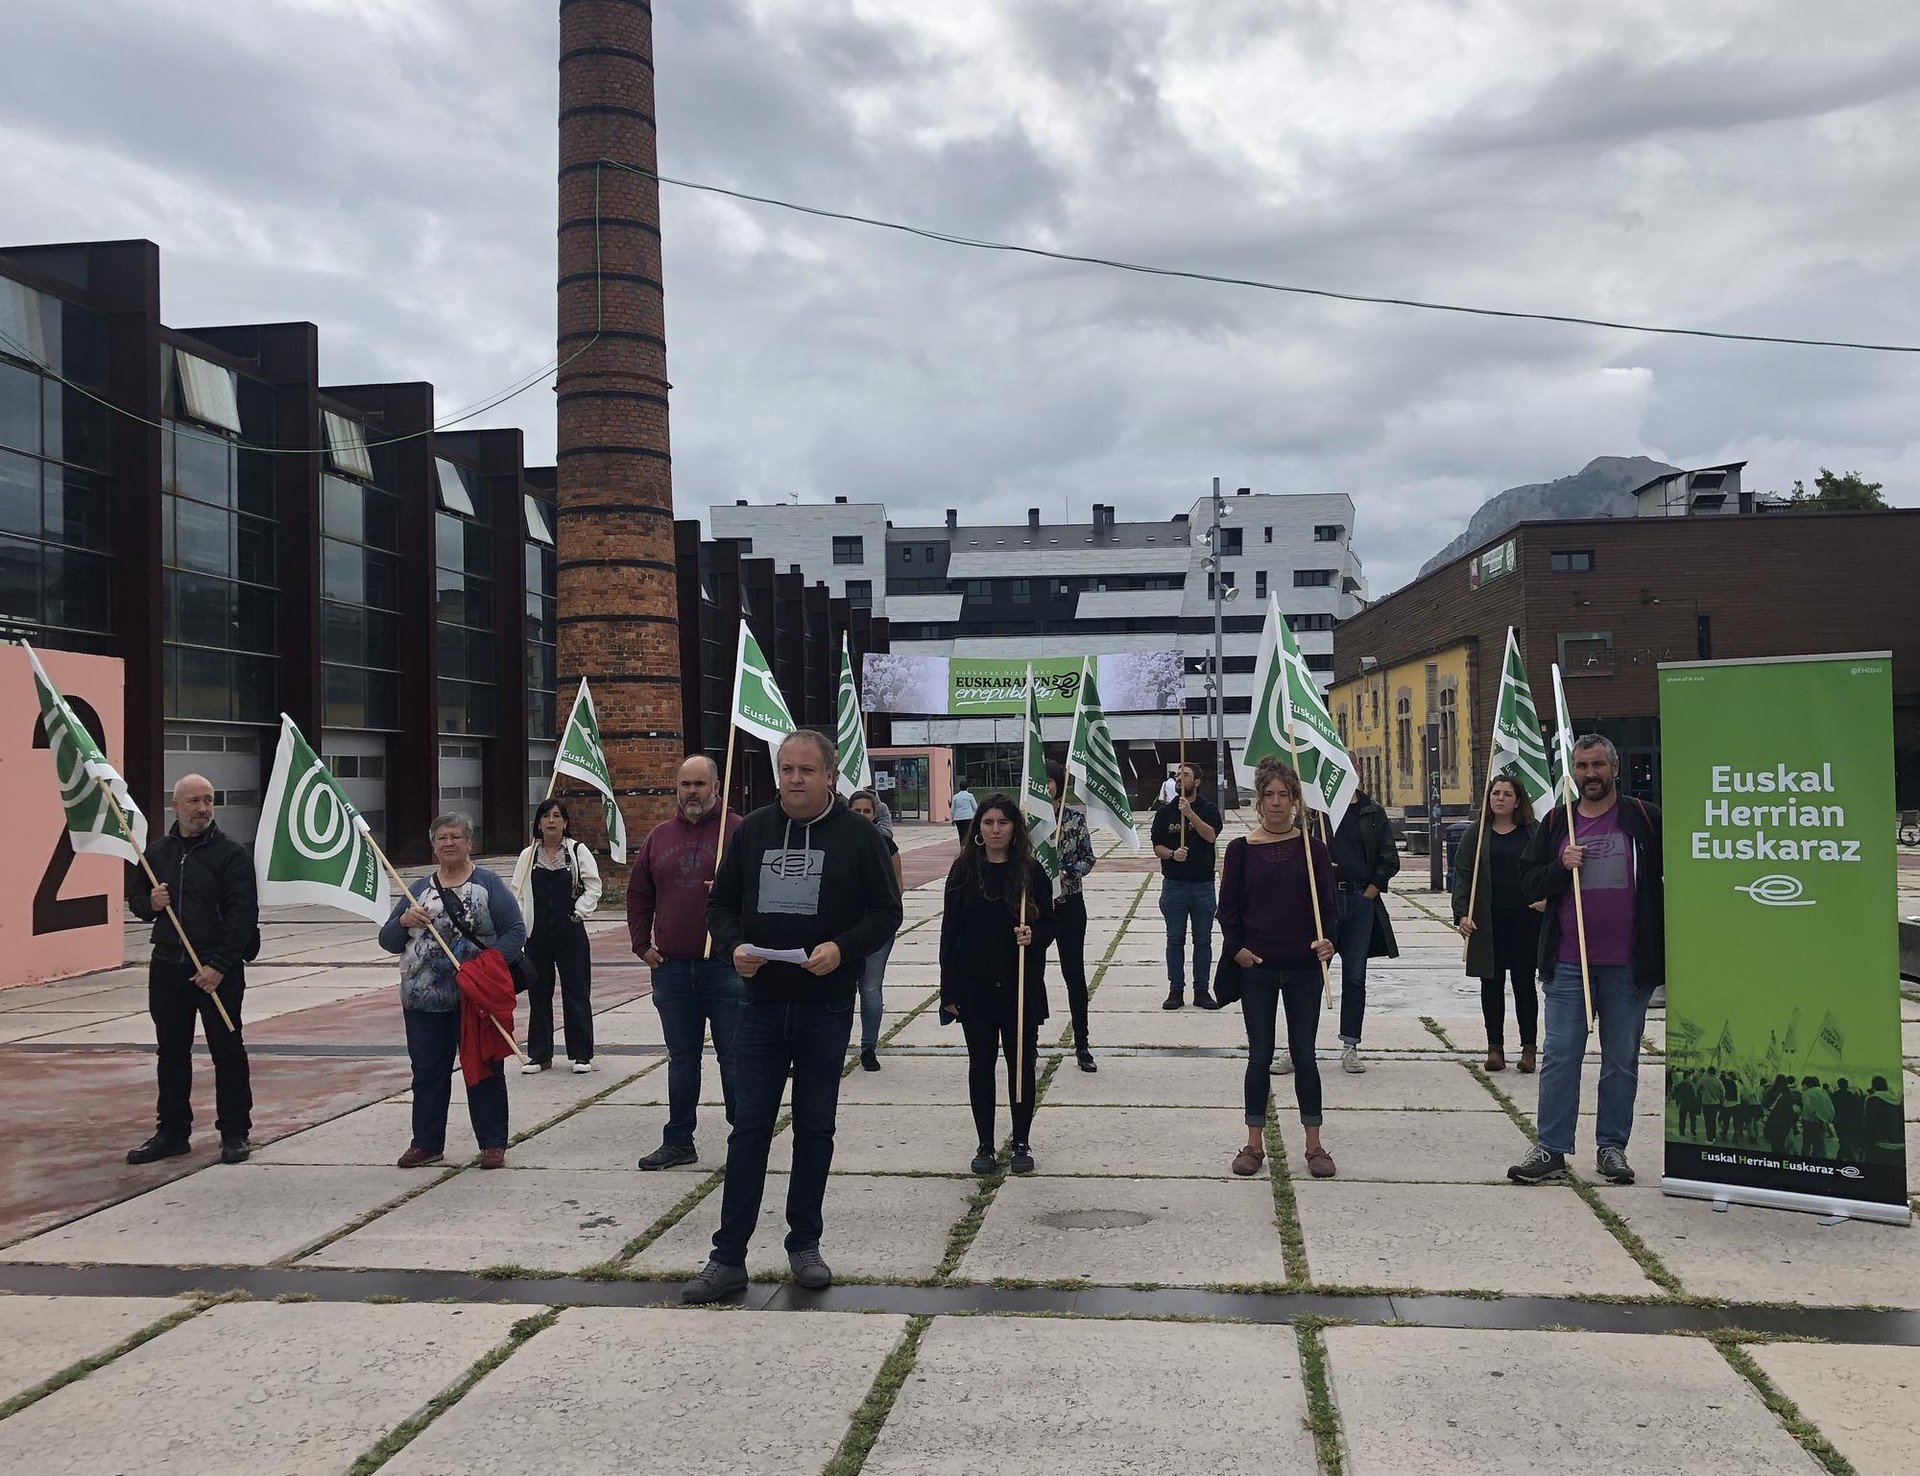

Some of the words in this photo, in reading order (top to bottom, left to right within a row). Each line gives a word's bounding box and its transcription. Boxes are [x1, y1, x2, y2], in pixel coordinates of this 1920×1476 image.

[955, 676, 1051, 688] EUSKARAEN
[743, 704, 783, 728] Euskal
[562, 749, 594, 770] Euskal
[1712, 763, 1835, 793] Euskal
[1097, 785, 1133, 823] Euskaraz
[1705, 797, 1844, 827] Herrian
[1692, 831, 1861, 862] Euskaraz
[1701, 1151, 1737, 1164] Euskal
[1738, 1155, 1780, 1169] Herrian
[1782, 1160, 1834, 1175] Euskaraz
